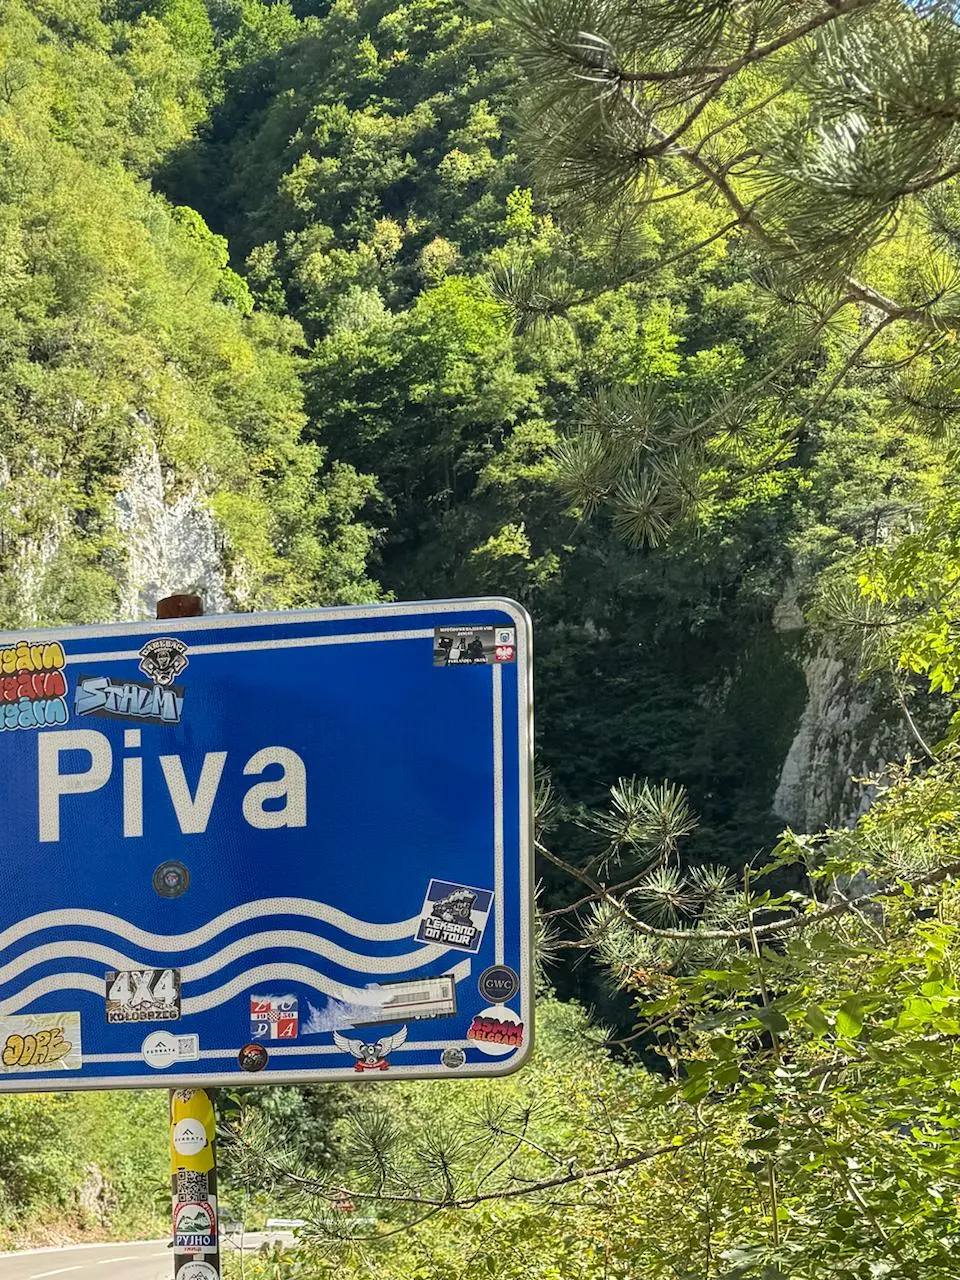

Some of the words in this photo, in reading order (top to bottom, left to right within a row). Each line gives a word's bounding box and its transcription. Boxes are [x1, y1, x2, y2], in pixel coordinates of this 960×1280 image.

[38, 728, 307, 842] Piva
[425, 927, 441, 939] ON
[442, 931, 471, 946] TOUR
[426, 918, 476, 937] LEKSAND
[485, 980, 512, 989] GWC
[468, 1029, 523, 1047] BELGRADE
